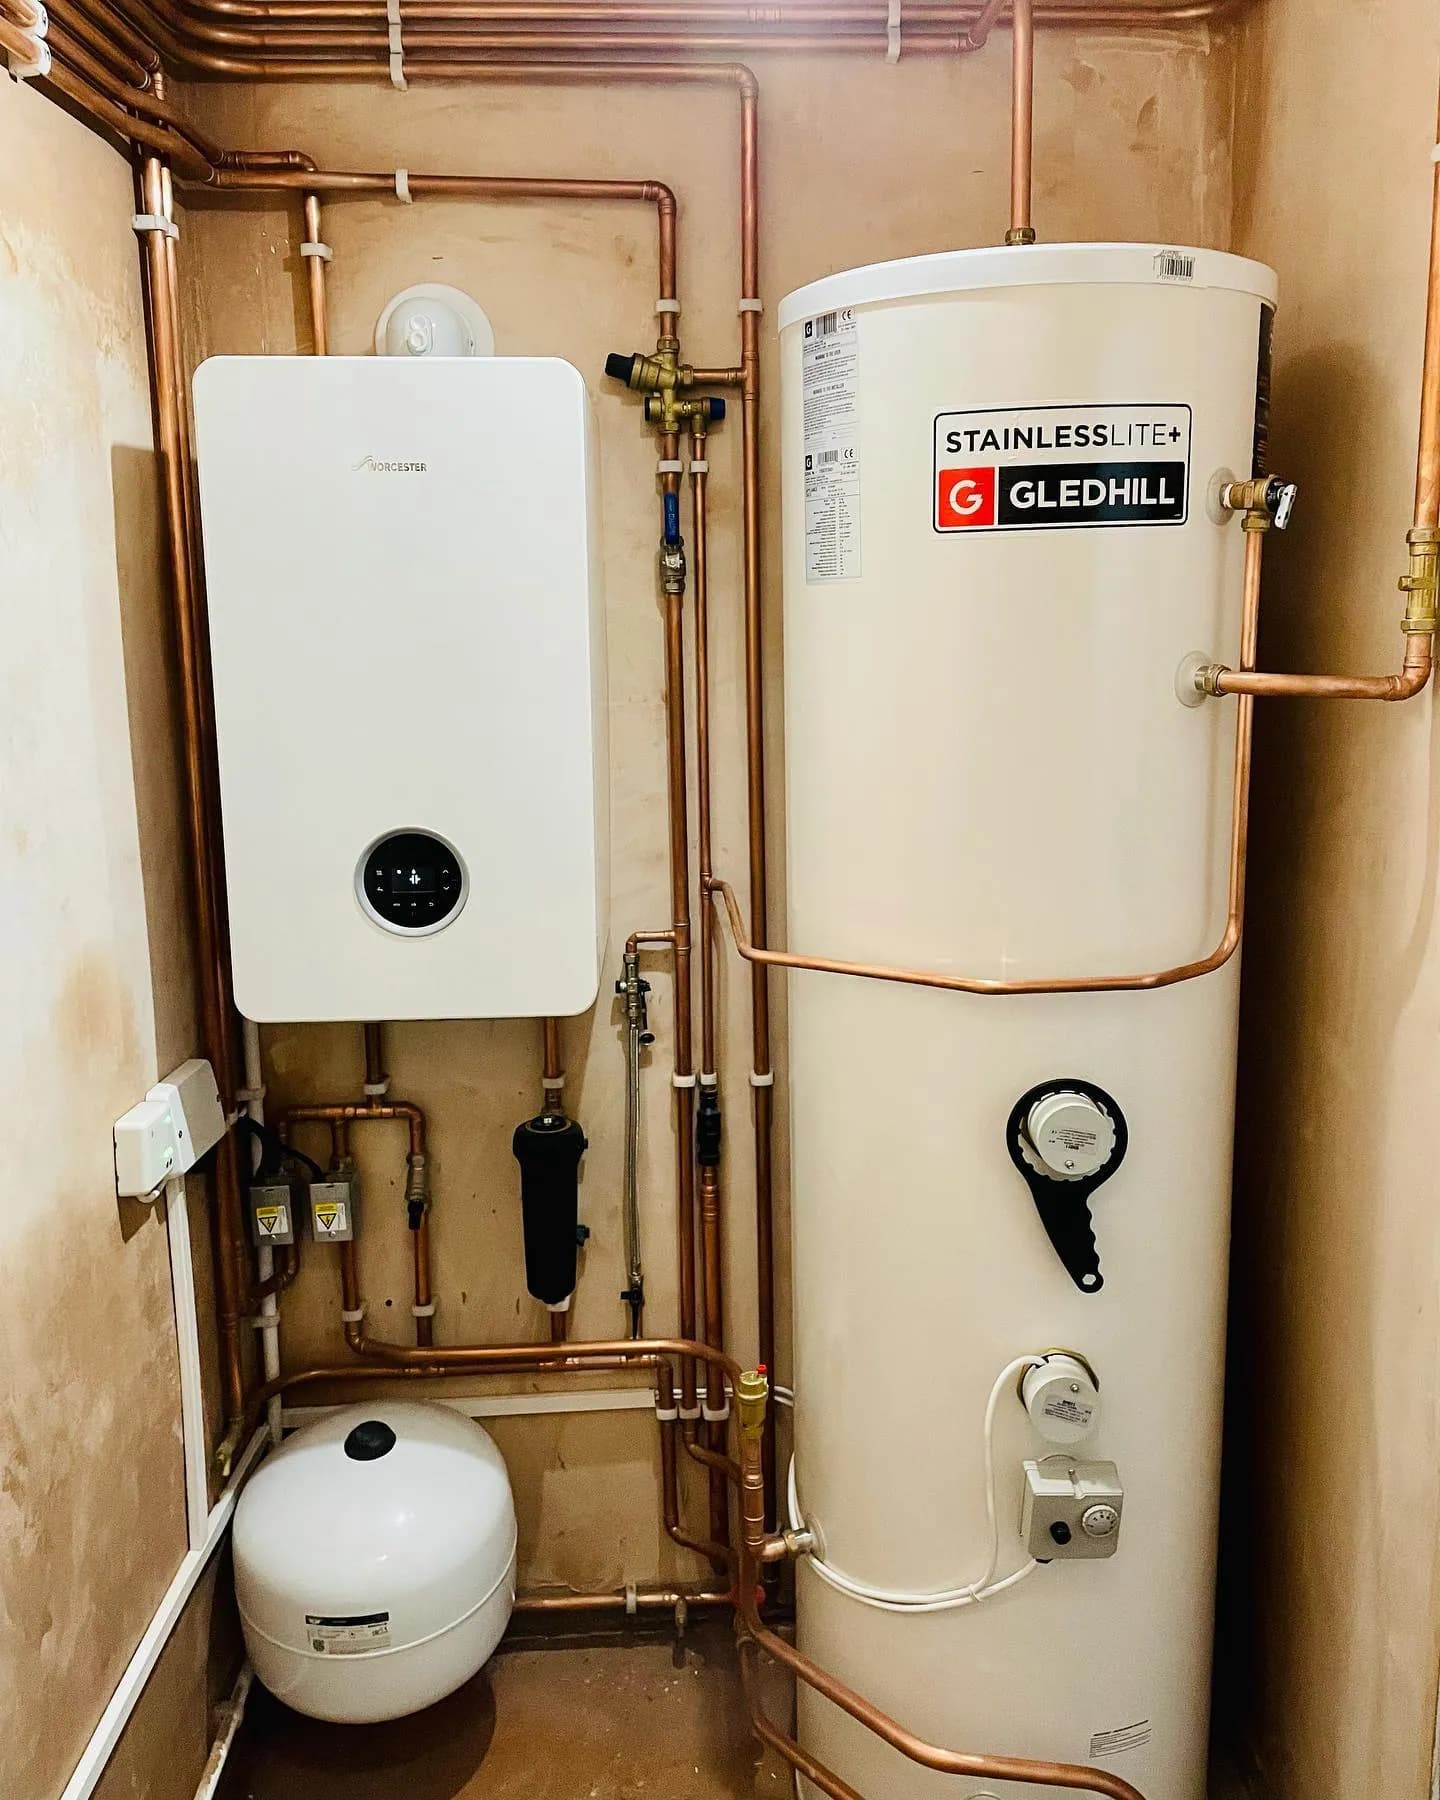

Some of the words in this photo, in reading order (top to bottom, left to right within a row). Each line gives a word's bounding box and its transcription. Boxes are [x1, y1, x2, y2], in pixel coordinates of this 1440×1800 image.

[945, 423, 1181, 453] STAINLESSLITE+
[367, 462, 428, 472] WORCESTER
[949, 479, 984, 515] G
[1009, 477, 1175, 509] GLEDHILL
